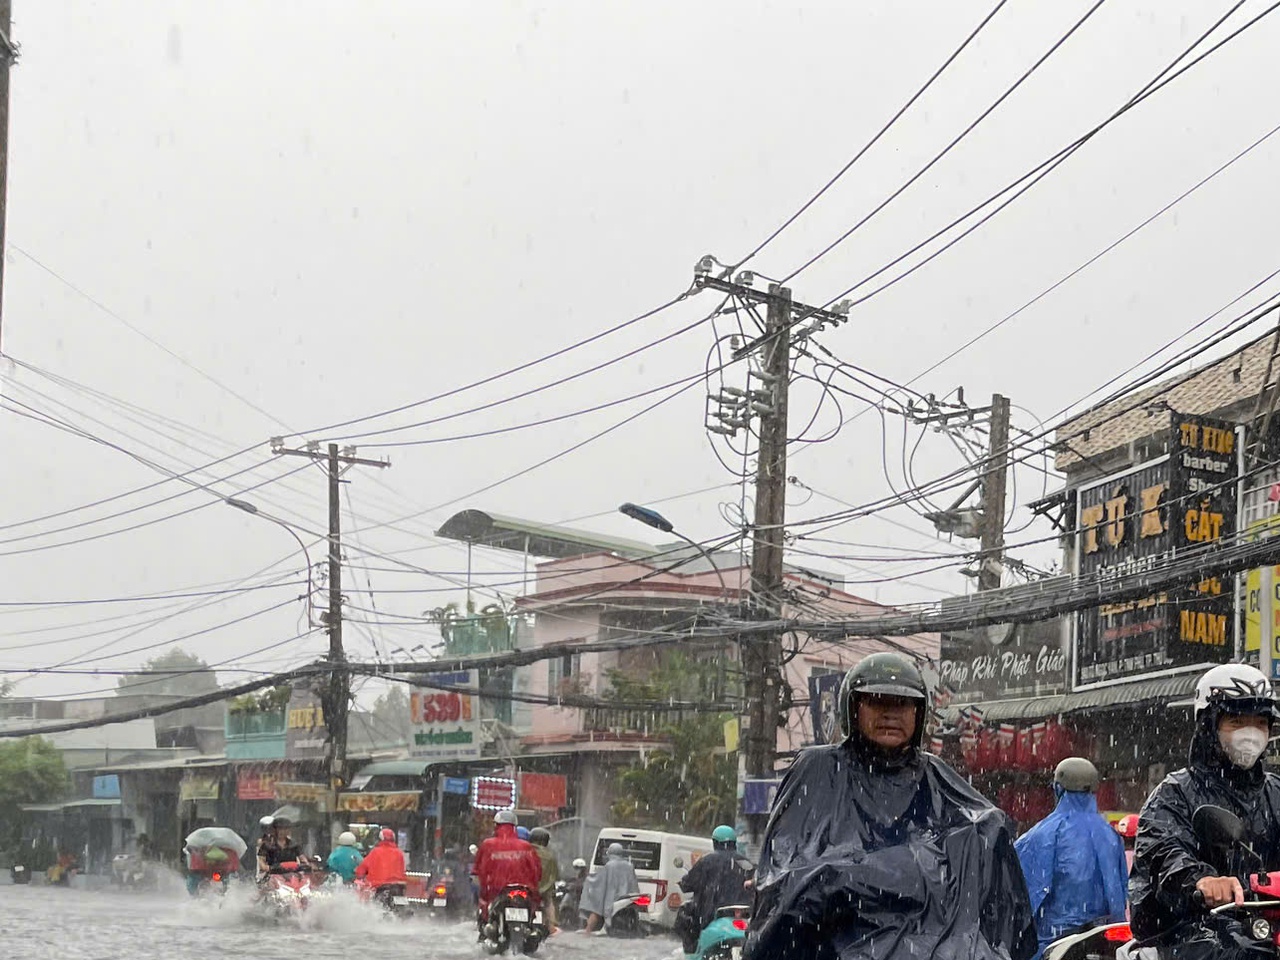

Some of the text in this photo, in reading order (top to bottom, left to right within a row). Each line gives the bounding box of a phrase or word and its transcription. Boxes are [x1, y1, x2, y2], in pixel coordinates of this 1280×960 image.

[1183, 453, 1228, 473] barber
[1082, 482, 1128, 554] TÚ
[1185, 498, 1223, 543] CẮT
[1181, 608, 1227, 646] NAM
[941, 660, 968, 689] Pháp
[1001, 651, 1031, 680] Phật
[1036, 645, 1065, 675] Giáo
